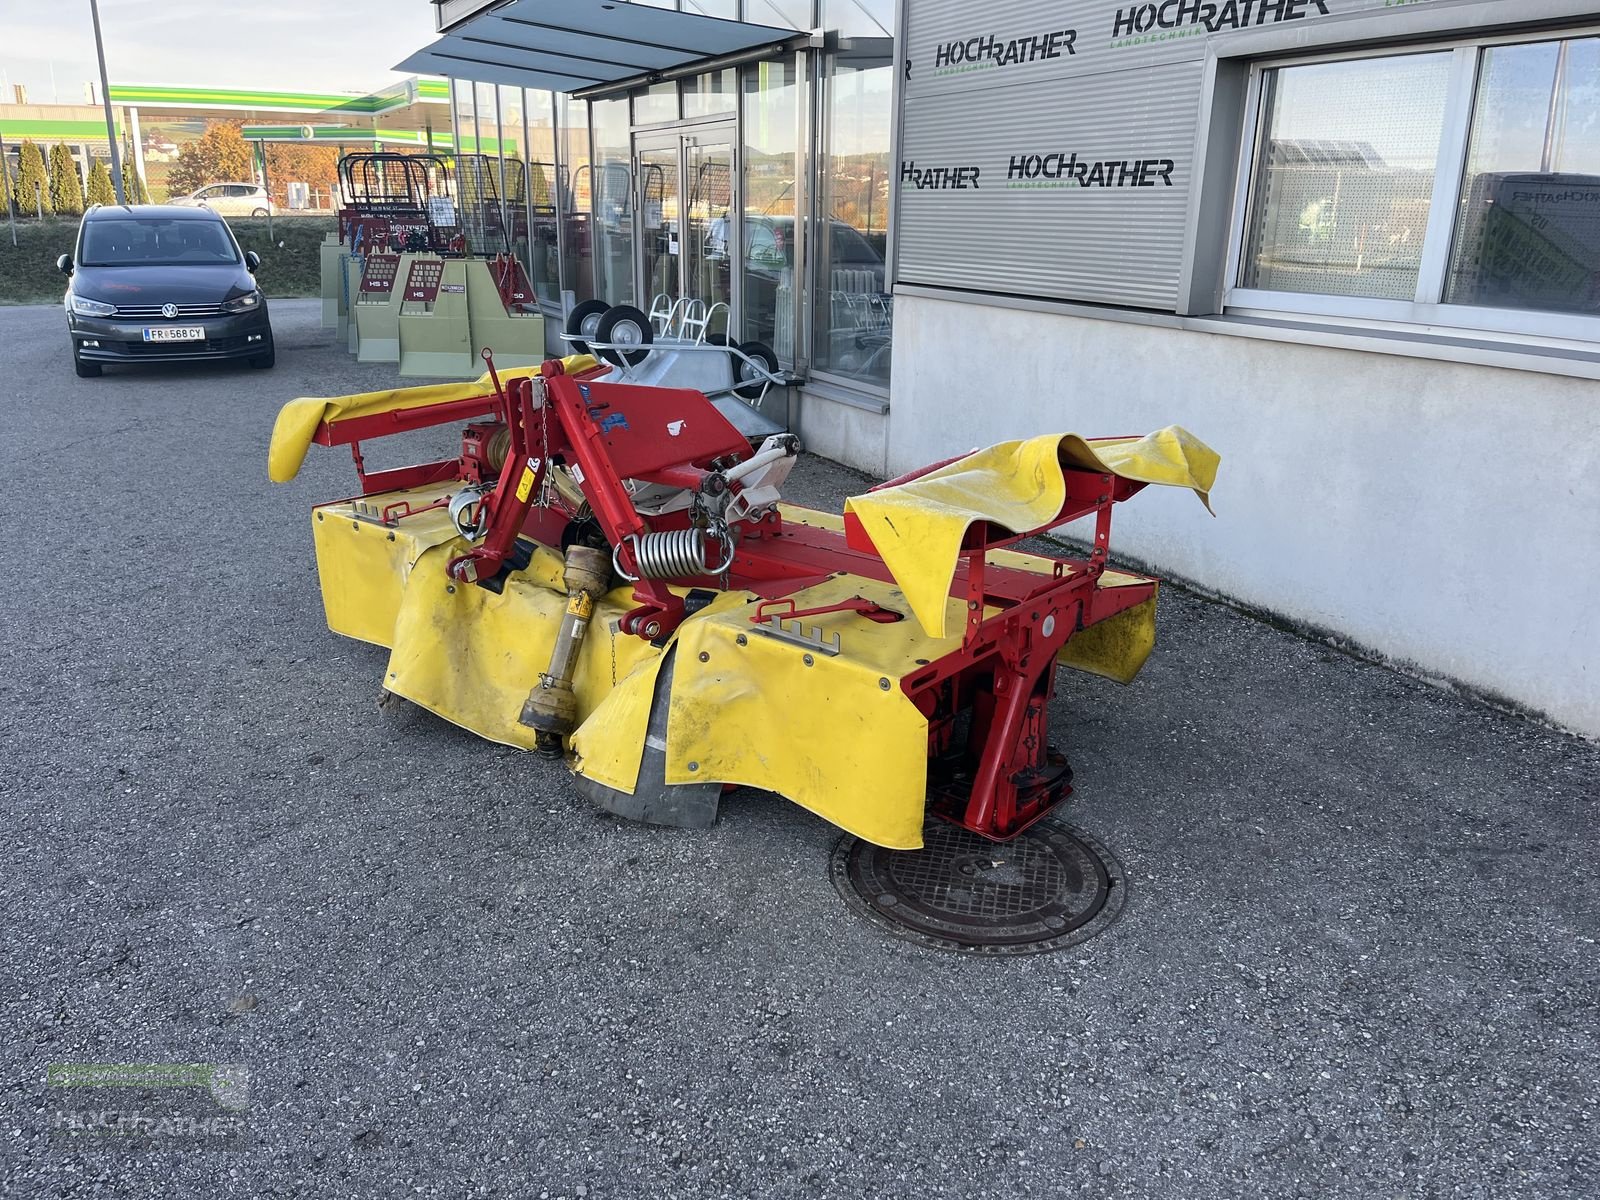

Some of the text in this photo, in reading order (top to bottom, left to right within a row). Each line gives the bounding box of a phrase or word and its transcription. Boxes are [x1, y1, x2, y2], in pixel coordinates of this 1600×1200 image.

[935, 29, 1078, 68] HOCHRATHER
[1109, 26, 1202, 49] LANDTECHNIK
[1007, 152, 1175, 188] HOCHRATHER
[151, 328, 201, 339] FR 568 CY
